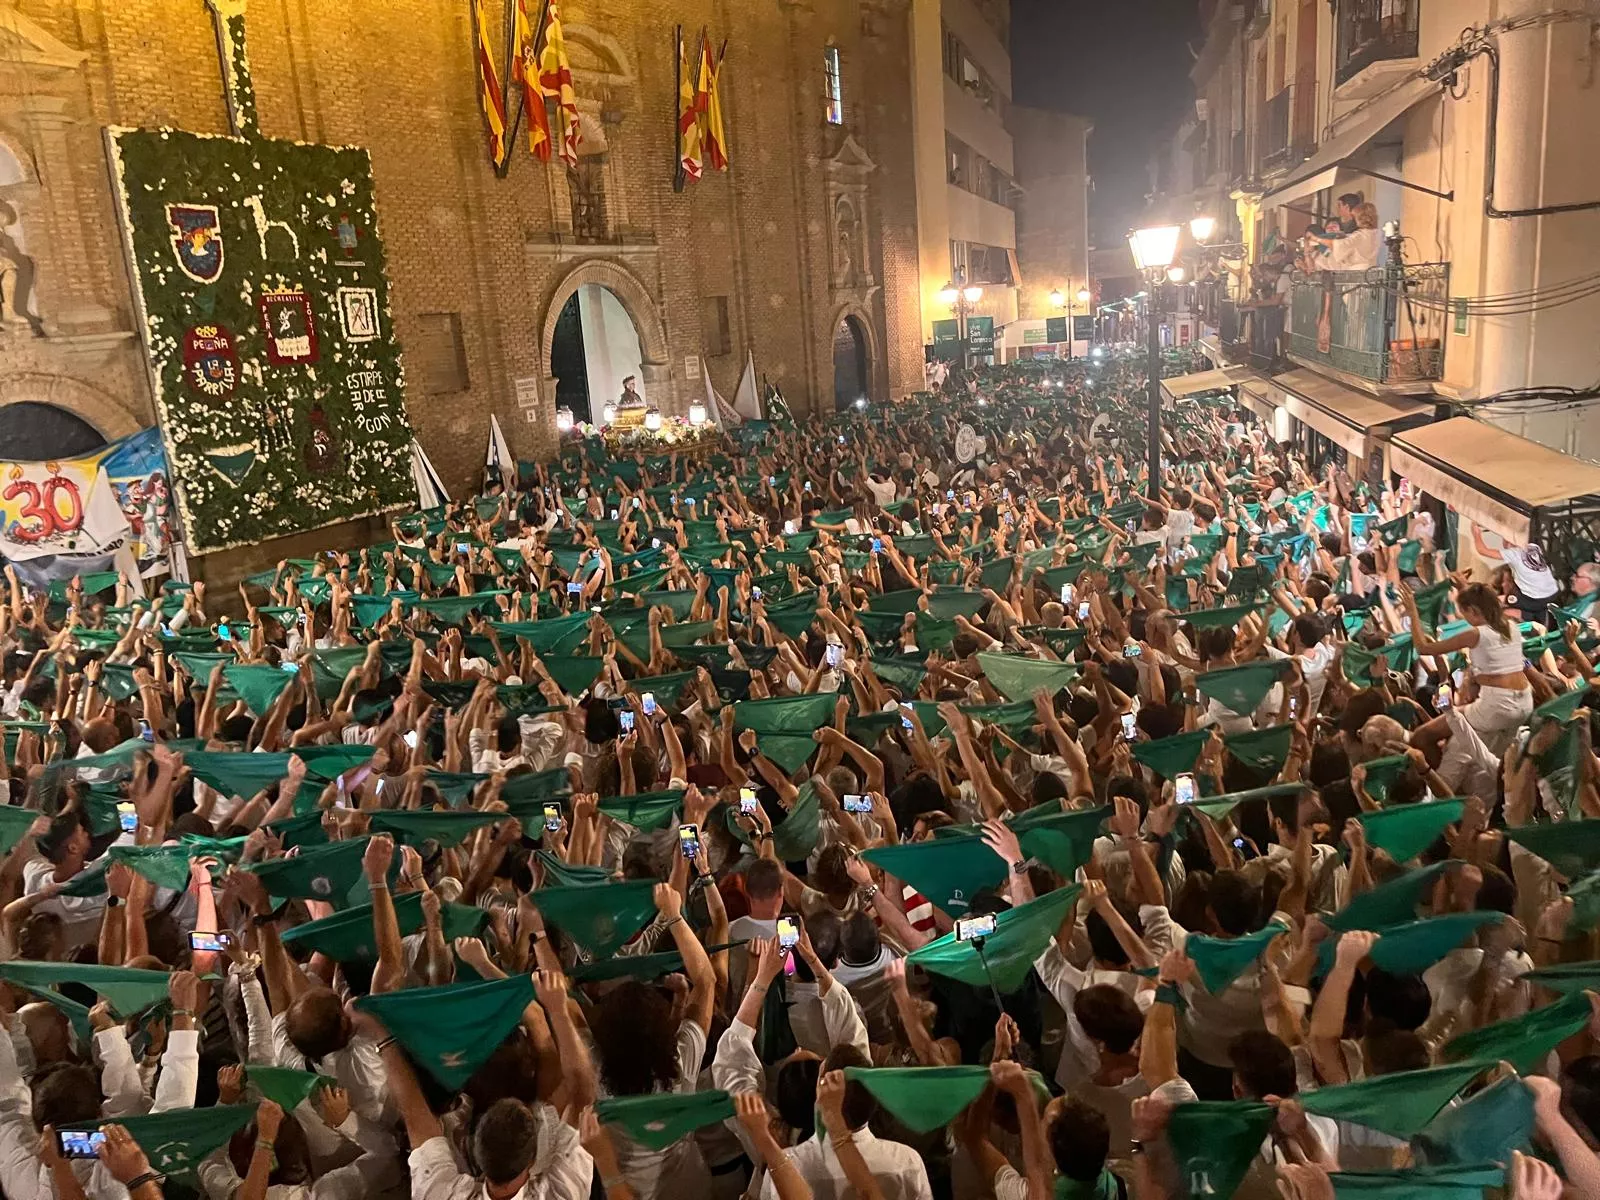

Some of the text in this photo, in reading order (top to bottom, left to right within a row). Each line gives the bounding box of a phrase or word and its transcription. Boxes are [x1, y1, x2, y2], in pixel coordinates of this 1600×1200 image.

[193, 337, 229, 350] PEÑA
[346, 371, 384, 389] ESTIRPE
[363, 389, 376, 403] DE
[3, 476, 84, 541] 30
